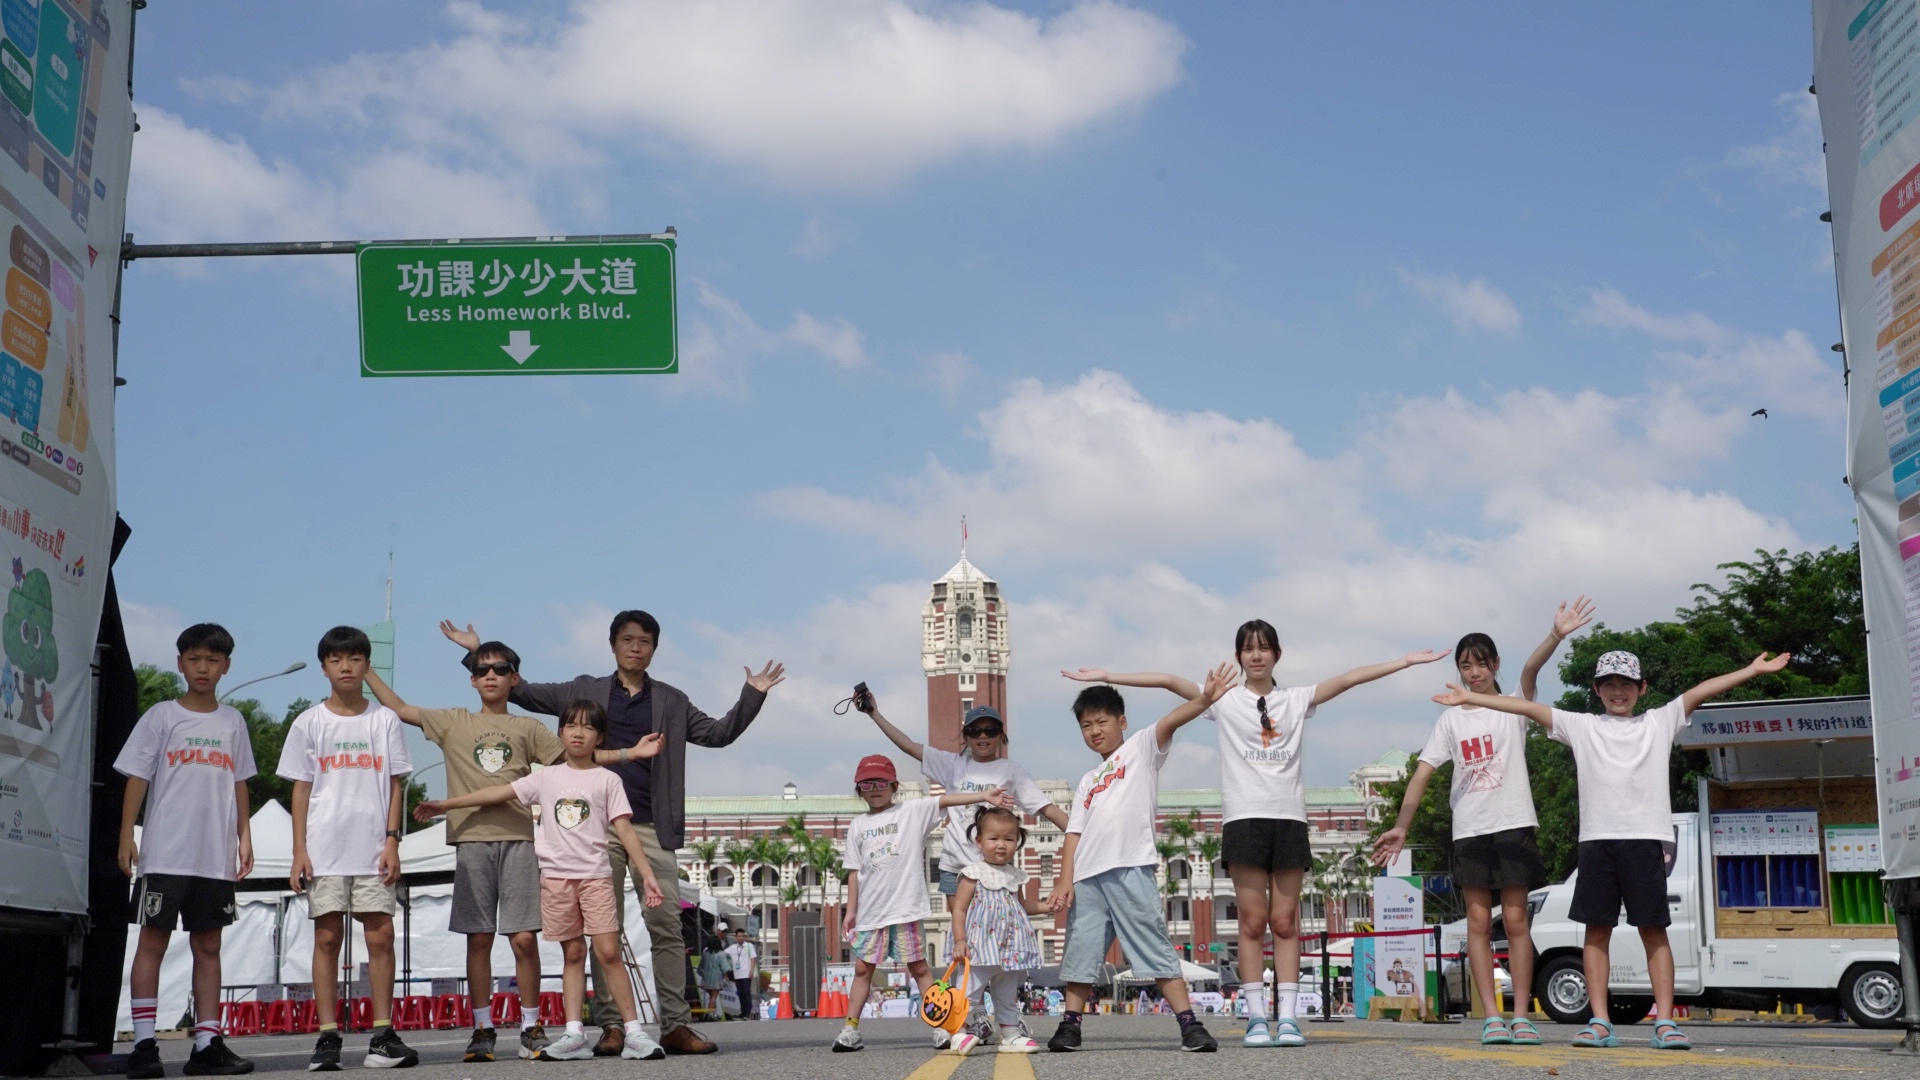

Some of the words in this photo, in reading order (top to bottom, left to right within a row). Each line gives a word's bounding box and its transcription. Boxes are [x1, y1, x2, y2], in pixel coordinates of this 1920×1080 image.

[397, 257, 637, 298] 功課少少大道
[407, 305, 451, 322] Less
[458, 303, 572, 321] Homework
[578, 302, 631, 320] Blvd.
[1702, 716, 1872, 735] 移動好重要！我的街道
[186, 737, 222, 747] TEAM
[335, 742, 369, 750] TEAM
[474, 731, 512, 743] CAMPING
[1460, 734, 1494, 761] Hi
[166, 749, 235, 773] YULON
[318, 753, 384, 773] YULON
